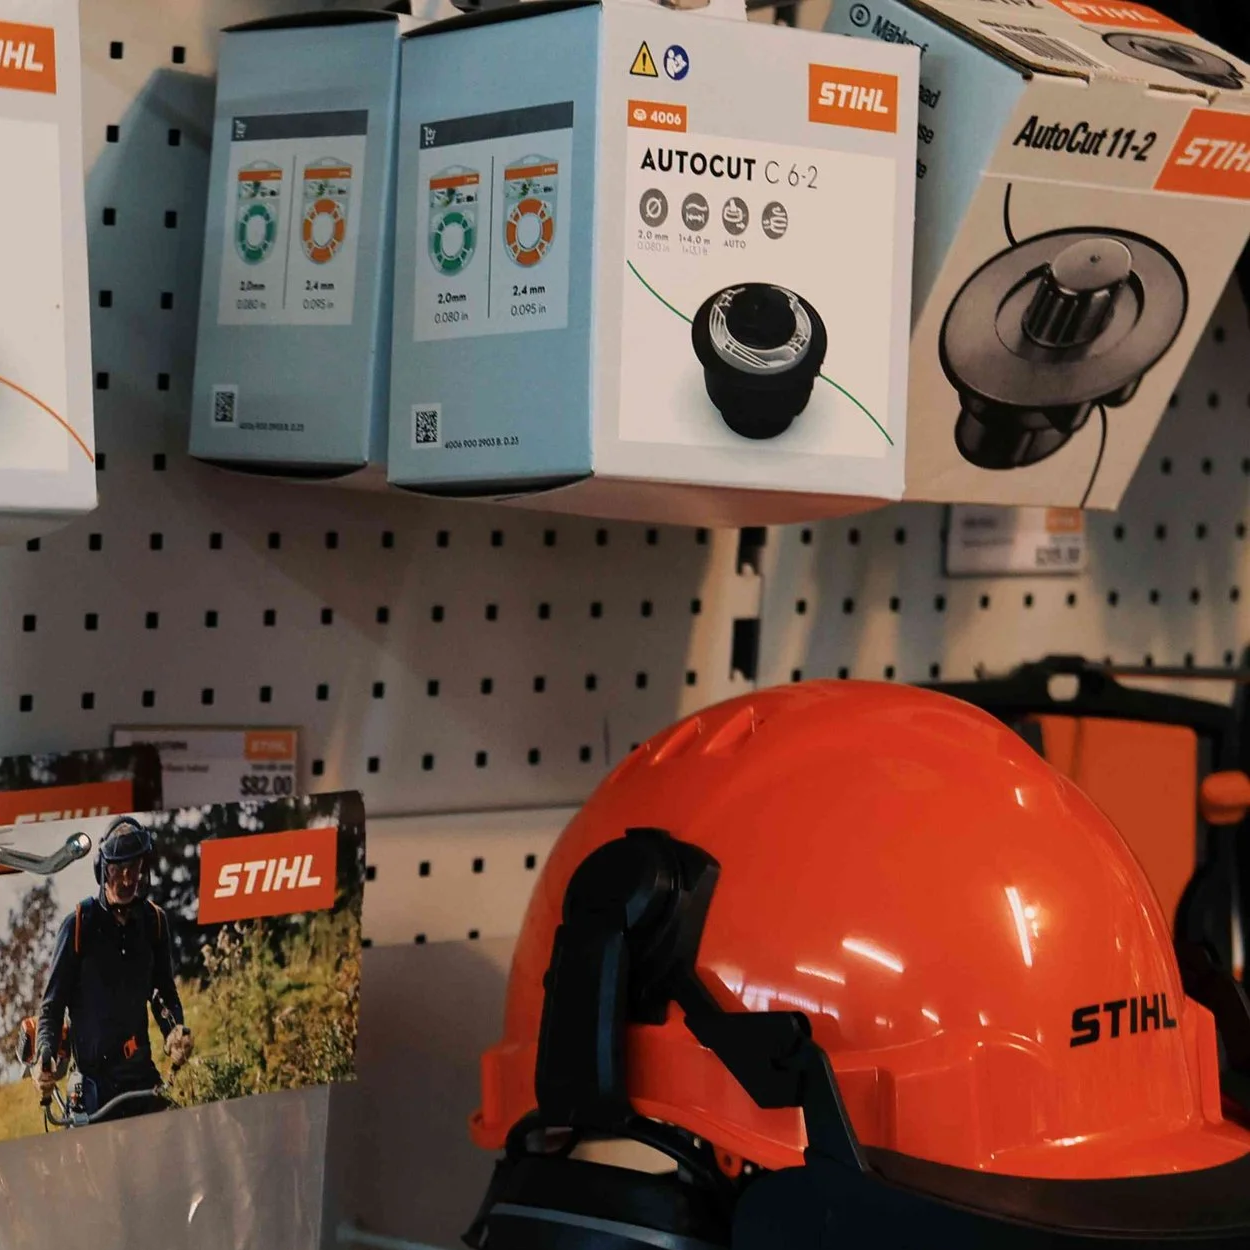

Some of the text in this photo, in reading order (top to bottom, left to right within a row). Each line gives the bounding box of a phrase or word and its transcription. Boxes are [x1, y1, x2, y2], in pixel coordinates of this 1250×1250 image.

[818, 82, 888, 114] STIHL
[650, 110, 682, 126] 4006
[1013, 115, 1158, 162] AutoCut 11-2
[1175, 137, 1250, 173] STIH
[640, 147, 818, 190] AUTOCUT C 6-2
[723, 239, 746, 249] AUTO
[529, 285, 546, 295] mm
[461, 311, 469, 321] in
[510, 303, 547, 317] 0.095 in
[240, 775, 293, 796] $82.00
[213, 853, 322, 899] STIHL
[1069, 992, 1177, 1049] STIHL
